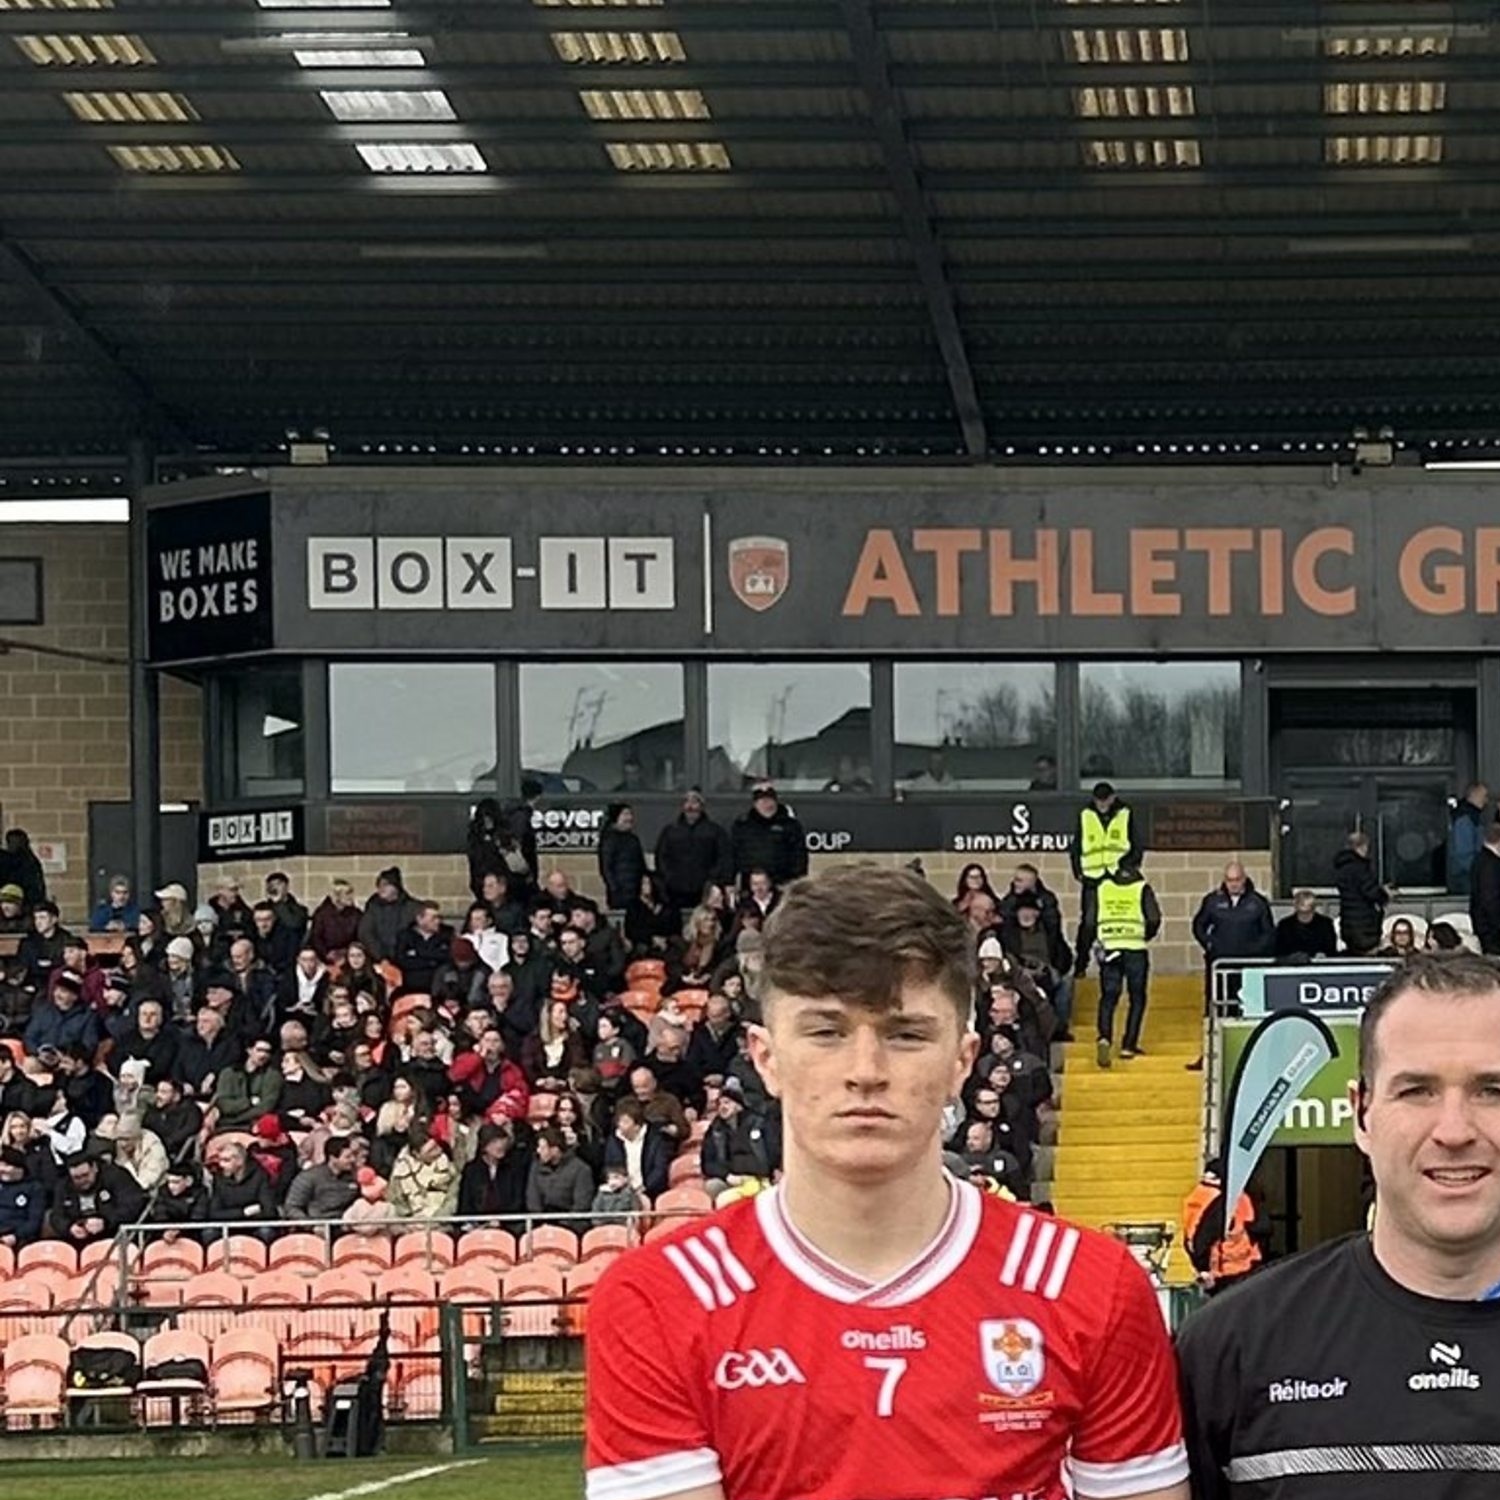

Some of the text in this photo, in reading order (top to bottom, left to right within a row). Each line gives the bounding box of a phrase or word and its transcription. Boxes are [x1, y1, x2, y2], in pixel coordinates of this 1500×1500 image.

[160, 538, 258, 581] WE MAKE
[320, 549, 660, 597] BOX-IT
[840, 527, 1358, 617] ATHLETIC
[160, 578, 258, 622] BOXES
[210, 815, 291, 843] BOX-IT
[714, 1346, 806, 1391] GAA
[863, 1354, 908, 1417] 7
